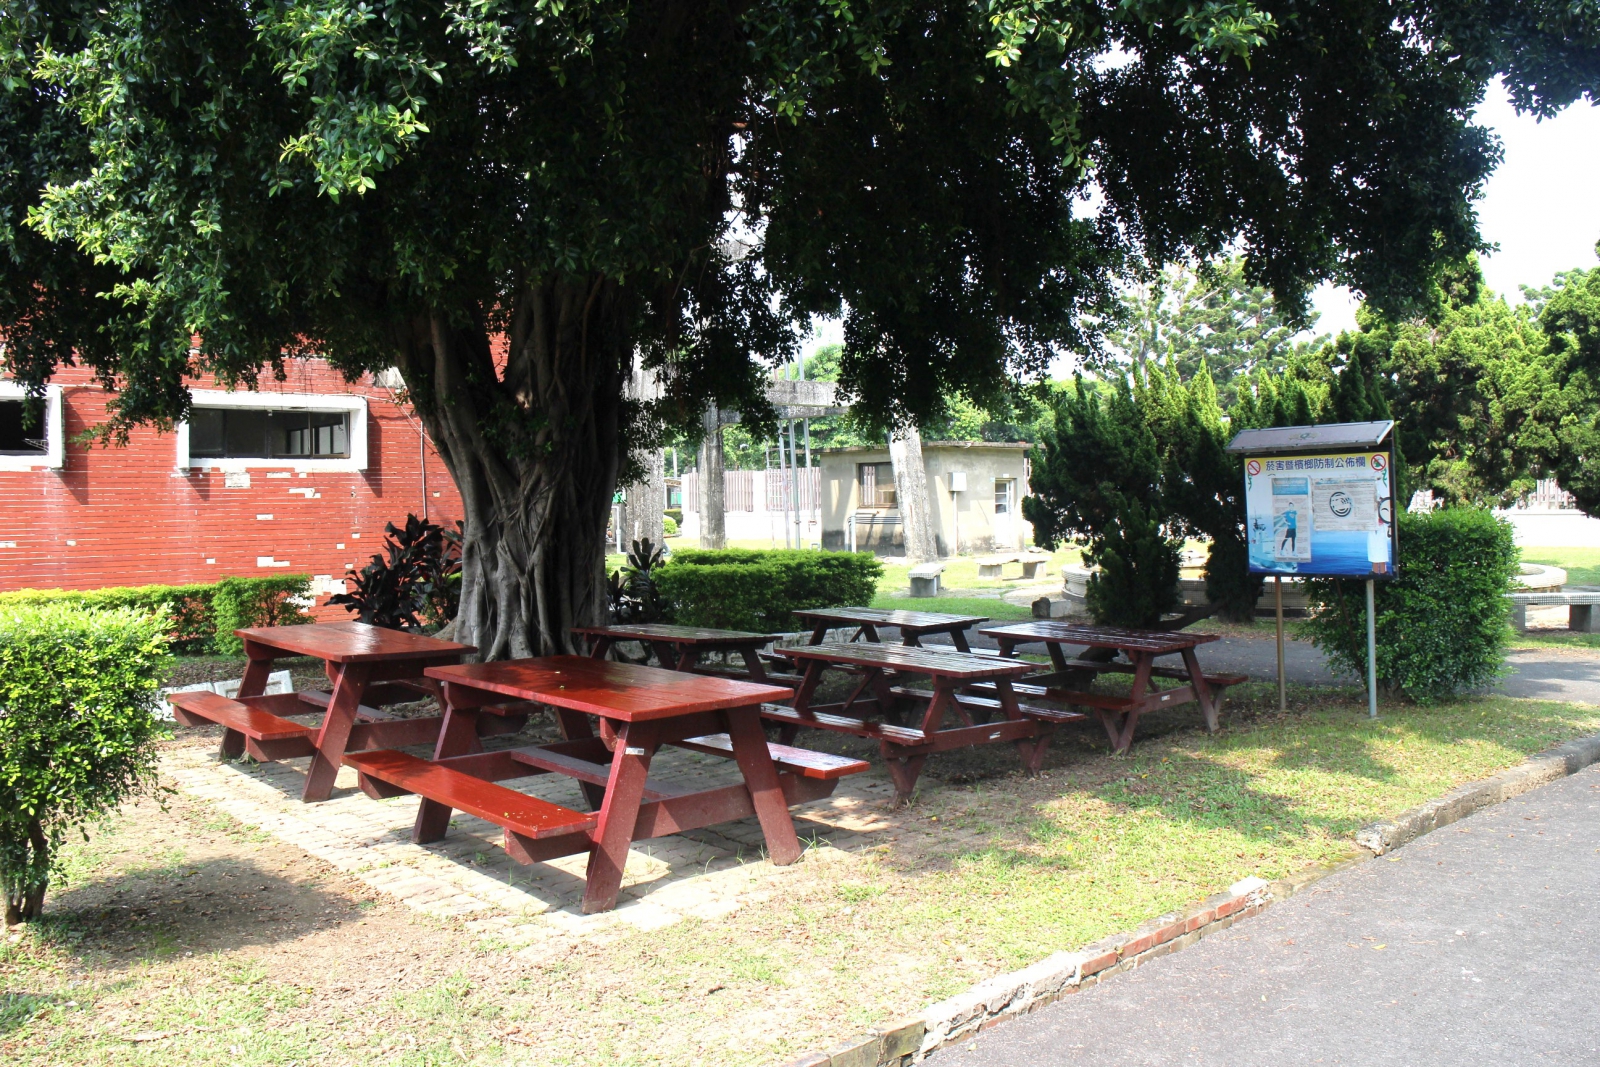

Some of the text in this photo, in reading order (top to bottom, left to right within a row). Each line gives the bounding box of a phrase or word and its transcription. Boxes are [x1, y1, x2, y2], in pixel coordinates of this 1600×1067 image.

[1265, 456, 1366, 471] 菸害暨檳榔防制公佈欄
